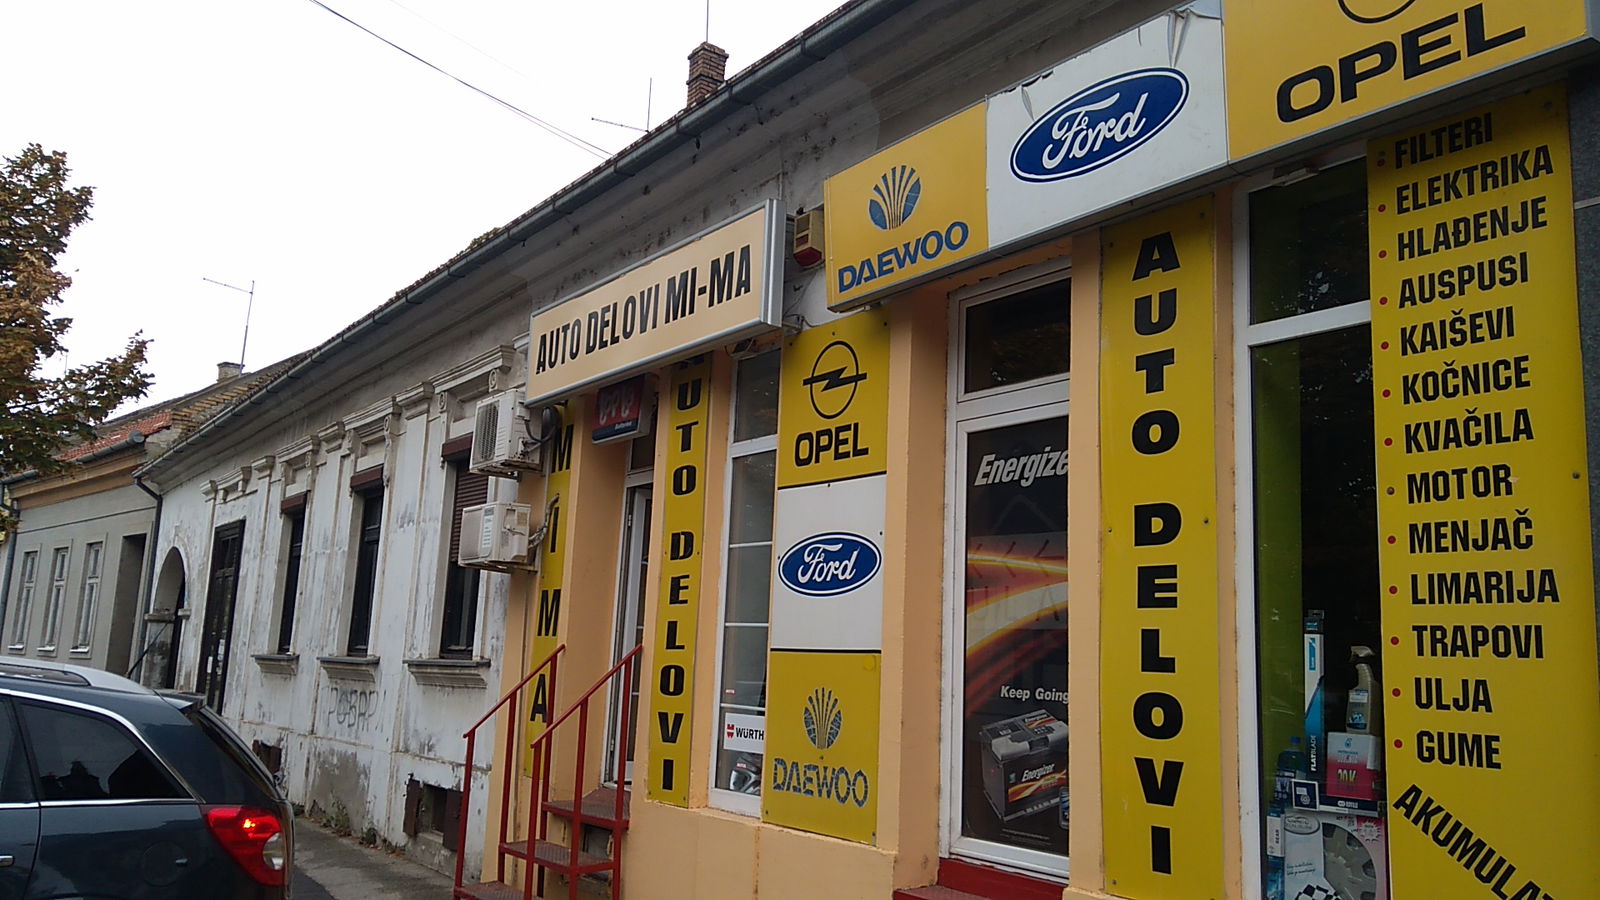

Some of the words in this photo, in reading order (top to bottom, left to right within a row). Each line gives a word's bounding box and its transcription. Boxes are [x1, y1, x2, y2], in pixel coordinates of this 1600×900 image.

[1277, 3, 1526, 123] OPEL
[1042, 91, 1149, 170] Ford
[1395, 112, 1493, 170] FILTERI
[1396, 144, 1553, 215] ELEKTRIKA
[1397, 196, 1548, 262] HLAĐENJE
[838, 221, 969, 293] DAEWOO
[1399, 251, 1529, 309] AUSPUSI
[535, 318, 582, 375] AUTO
[585, 283, 660, 355] DELOVI
[664, 244, 751, 325] MI-MA
[1400, 306, 1515, 356] KAIŠEVI
[1132, 231, 1181, 456] AUTO
[1402, 355, 1531, 404] KOČNICE
[794, 422, 869, 467] OPEL
[1404, 407, 1534, 454] KVAČILA
[1407, 464, 1513, 504] MOTOR
[1409, 508, 1534, 554] MENJAČ
[798, 543, 861, 584] Ford
[1411, 569, 1560, 605] LIMARIJA
[658, 531, 695, 791] DELOVI
[1412, 625, 1544, 659] TRAPOVI
[1000, 685, 1030, 701] Keep
[1132, 502, 1185, 875] DELOVI
[1414, 677, 1493, 713] ULJA
[736, 727, 764, 741] WÜRTH
[1416, 730, 1502, 770] GUME
[773, 757, 869, 808] DAEWOO
[1021, 763, 1055, 783] Energizer
